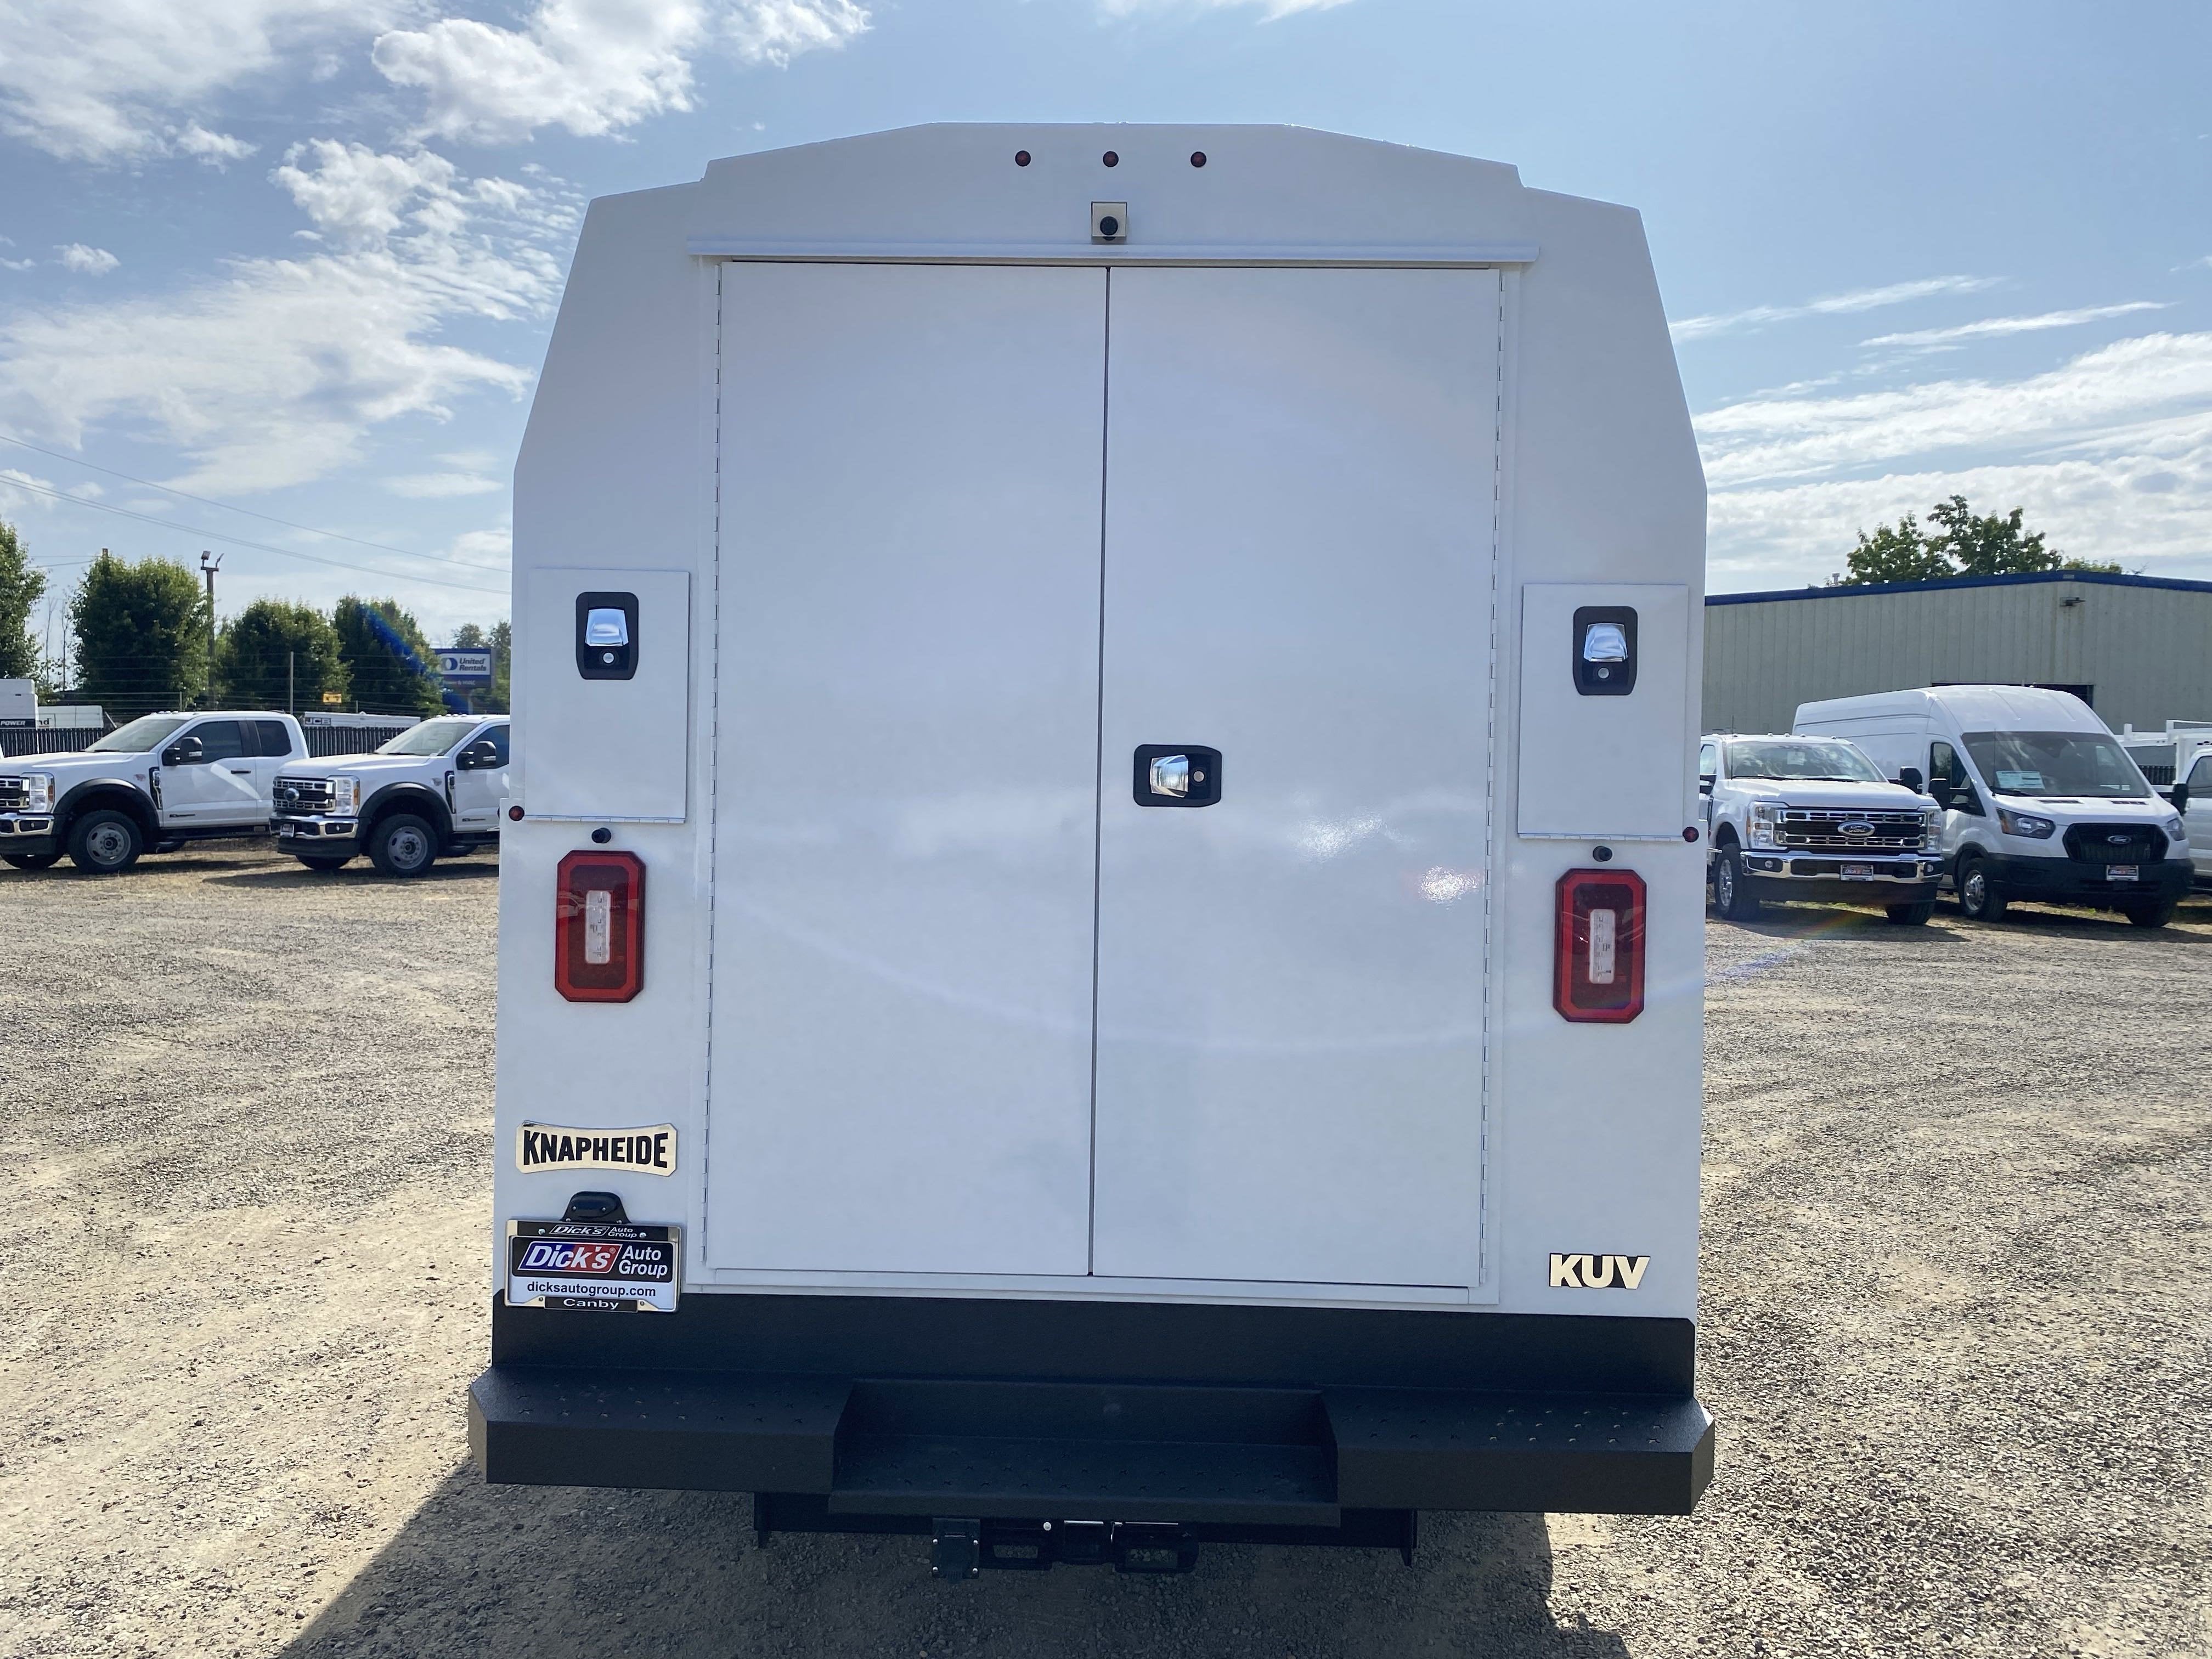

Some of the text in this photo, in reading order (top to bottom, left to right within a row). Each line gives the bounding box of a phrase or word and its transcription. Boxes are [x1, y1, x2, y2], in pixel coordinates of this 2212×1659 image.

[305, 717, 331, 725] JCB
[523, 1130, 669, 1169] KNAPHEIDE
[554, 1226, 605, 1235] Dick's
[526, 1244, 662, 1269] Dick's Auto
[618, 1260, 668, 1278] Group
[1550, 1253, 1651, 1289] KUV
[527, 1282, 656, 1298] dicksautogroup.com
[563, 1299, 619, 1310] Canby
